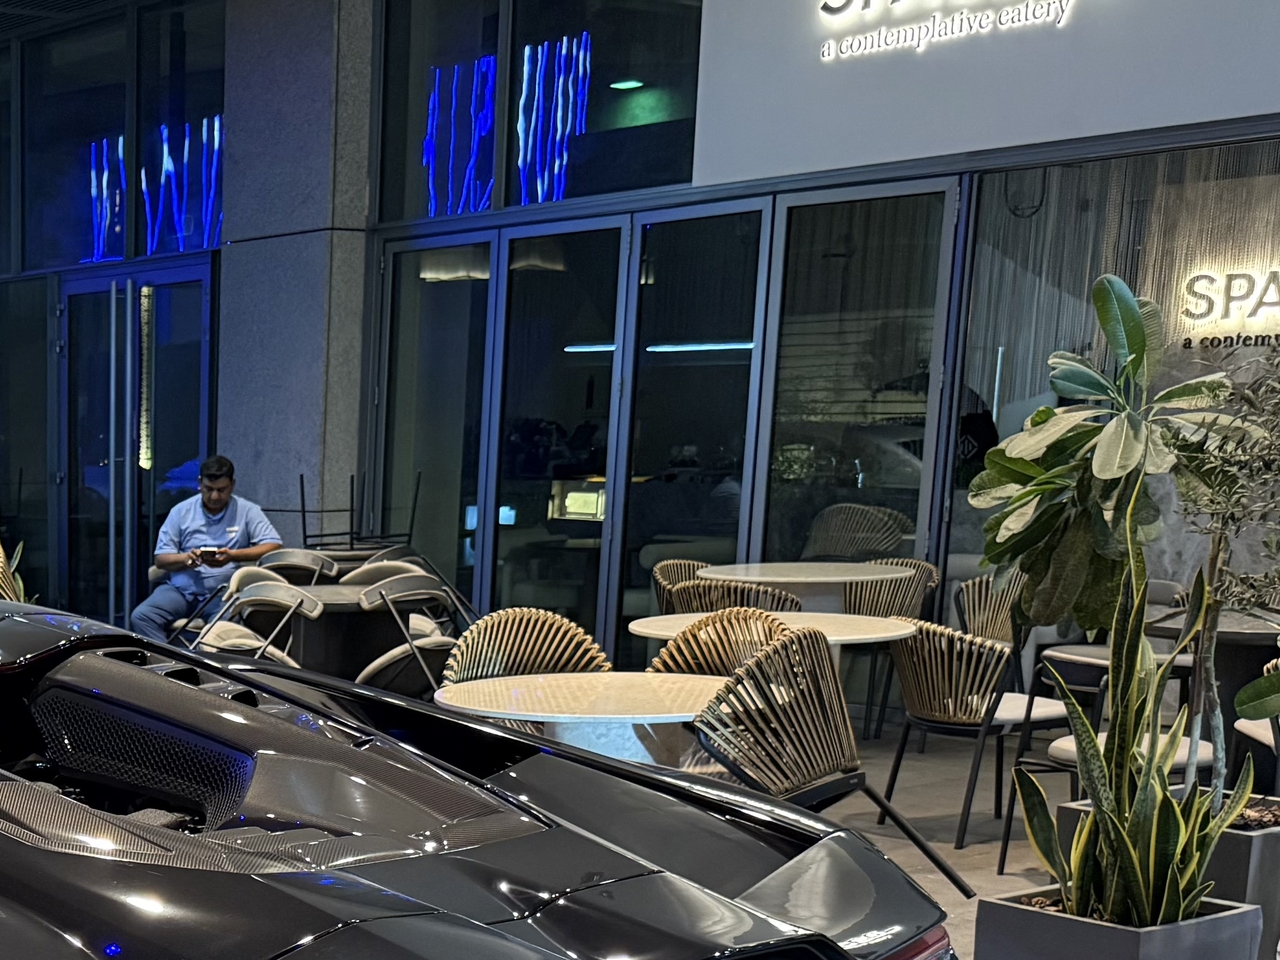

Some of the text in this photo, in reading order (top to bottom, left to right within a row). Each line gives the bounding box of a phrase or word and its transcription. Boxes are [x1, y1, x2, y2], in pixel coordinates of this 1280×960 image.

[821, 0, 1070, 58] a contemplative eatery
[1183, 337, 1193, 349] a
